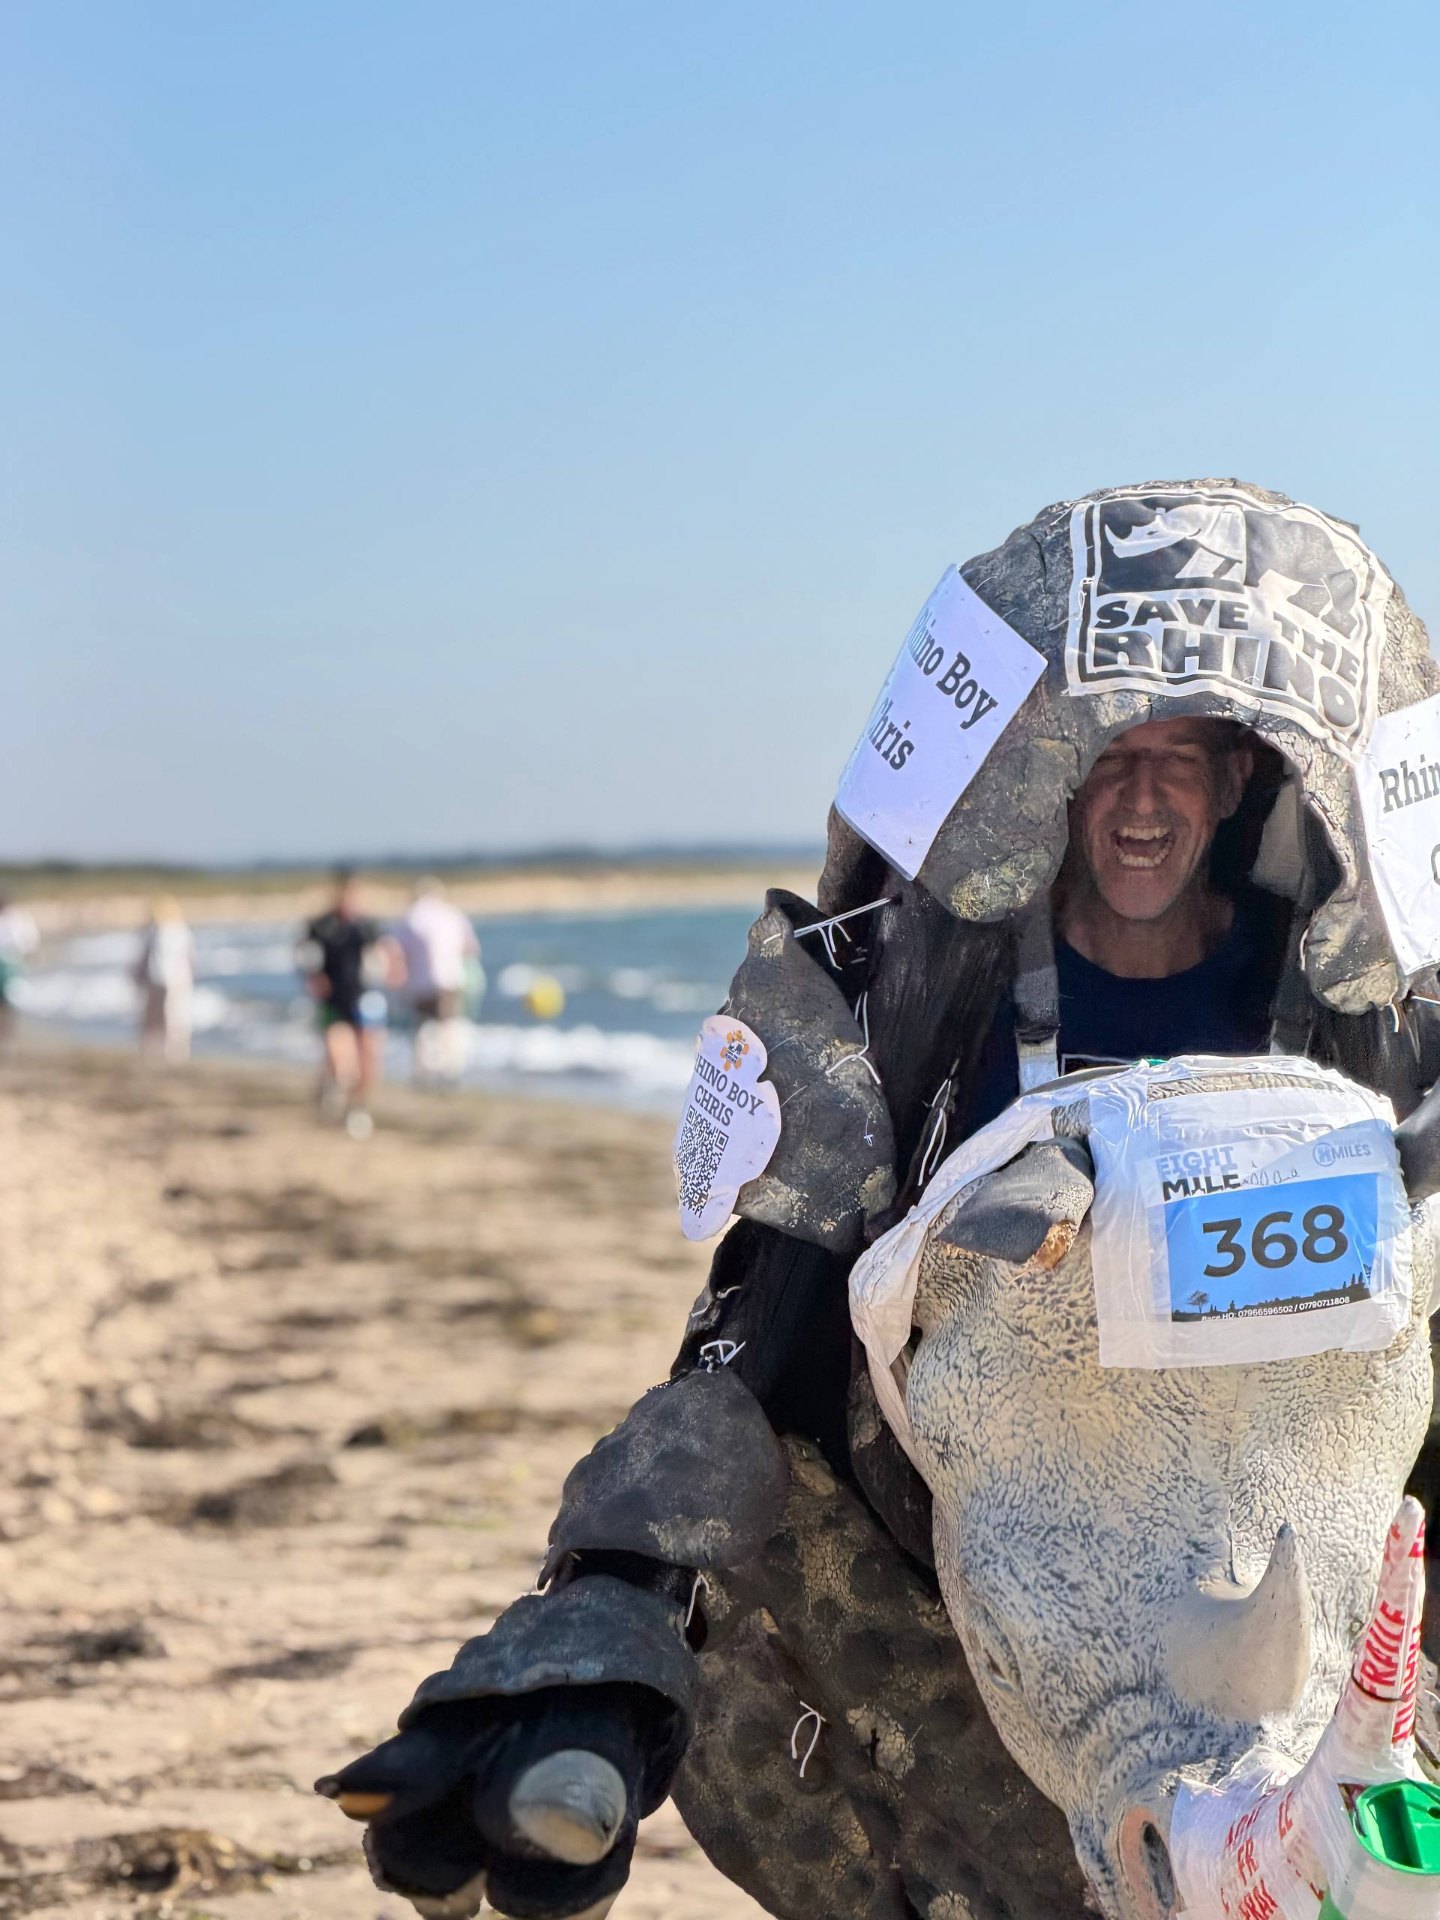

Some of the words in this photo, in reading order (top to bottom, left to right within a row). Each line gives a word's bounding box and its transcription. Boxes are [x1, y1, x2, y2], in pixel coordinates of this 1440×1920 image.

[1094, 599, 1249, 630] SAVE
[1273, 610, 1361, 687] THE
[936, 651, 998, 730] Boy
[1094, 628, 1357, 728] RHINO
[695, 1053, 728, 1092] HINO
[727, 1081, 764, 1117] BOY
[695, 1085, 734, 1127] CHRIS
[1155, 1146, 1236, 1175] EIGHT
[1159, 1166, 1241, 1202] MILE
[1203, 1205, 1348, 1278] 368
